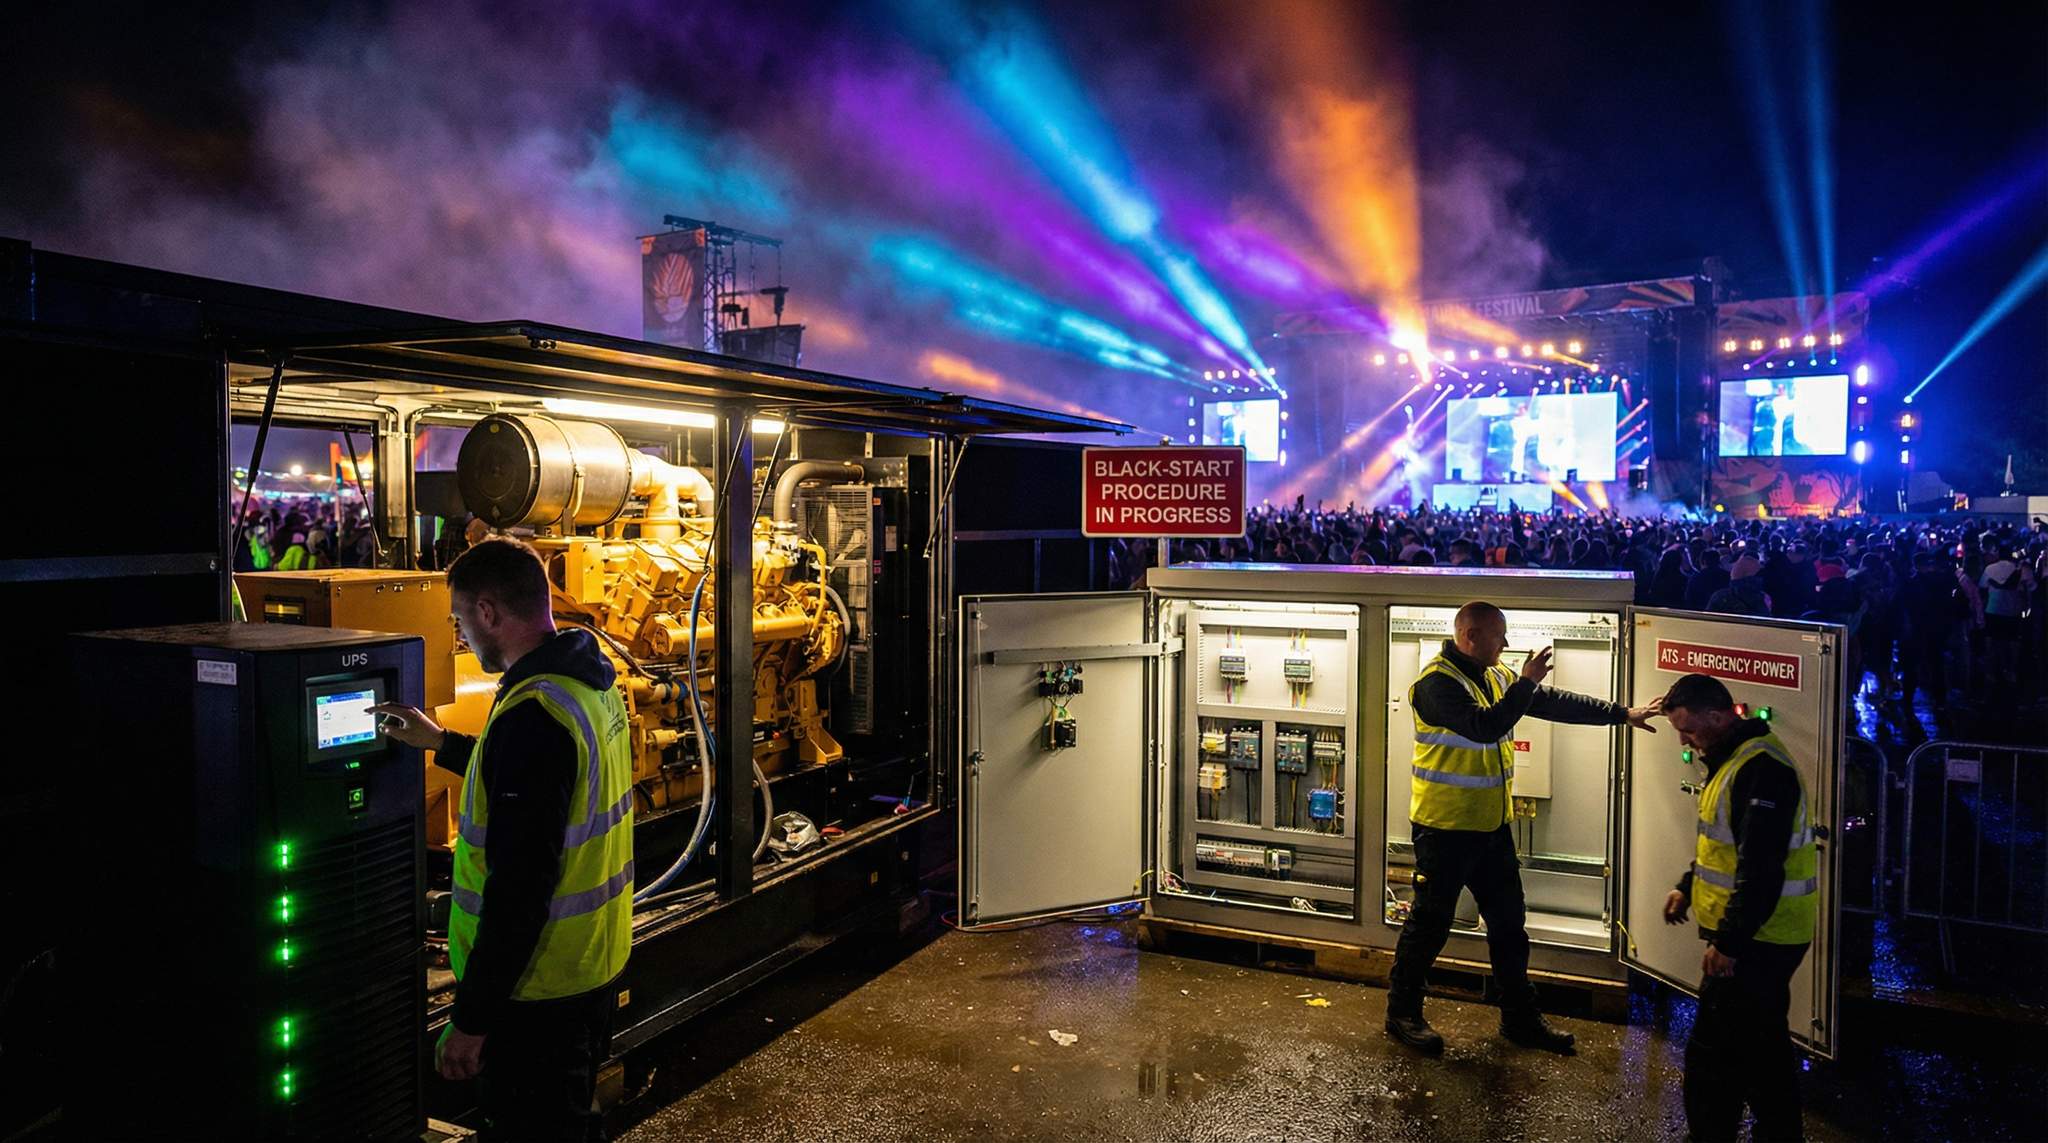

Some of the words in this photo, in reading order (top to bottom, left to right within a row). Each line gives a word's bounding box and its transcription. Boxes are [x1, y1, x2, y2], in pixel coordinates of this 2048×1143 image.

[1475, 295, 1544, 317] FESTIVAL
[1095, 460, 1234, 477] BLACK-START
[1102, 483, 1226, 500] PROCEDURE
[1095, 507, 1114, 523] IN
[1121, 507, 1232, 523] PROGRESS
[342, 653, 368, 667] UPS
[1661, 648, 1679, 664] ATS
[1687, 651, 1750, 674] EMERGENCY
[1753, 660, 1795, 680] POWER
